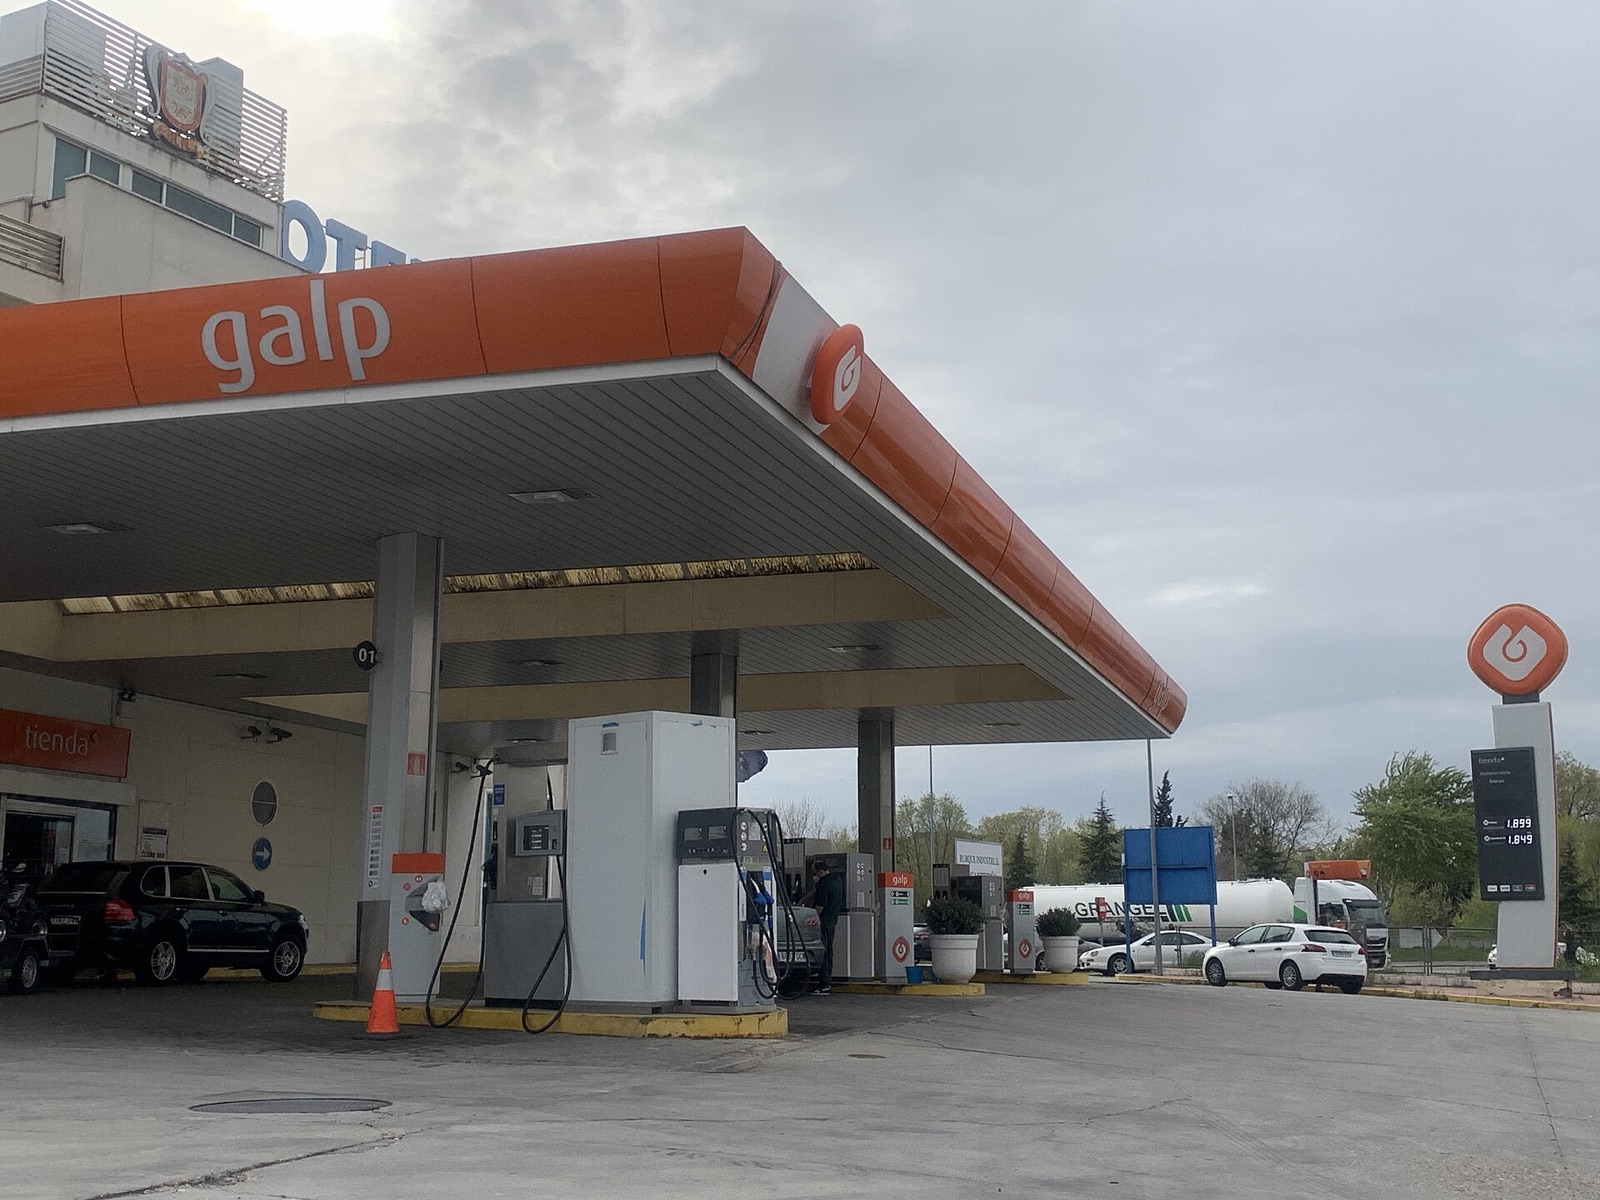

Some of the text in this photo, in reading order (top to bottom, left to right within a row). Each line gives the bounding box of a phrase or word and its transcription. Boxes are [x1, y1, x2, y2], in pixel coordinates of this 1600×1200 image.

[201, 279, 391, 394] galp
[358, 648, 375, 664] 01
[25, 724, 89, 756] tienda
[1506, 818, 1532, 829] 1.899
[1508, 834, 1533, 845] 1.849
[892, 874, 909, 886] galp
[1018, 892, 1031, 901] galp
